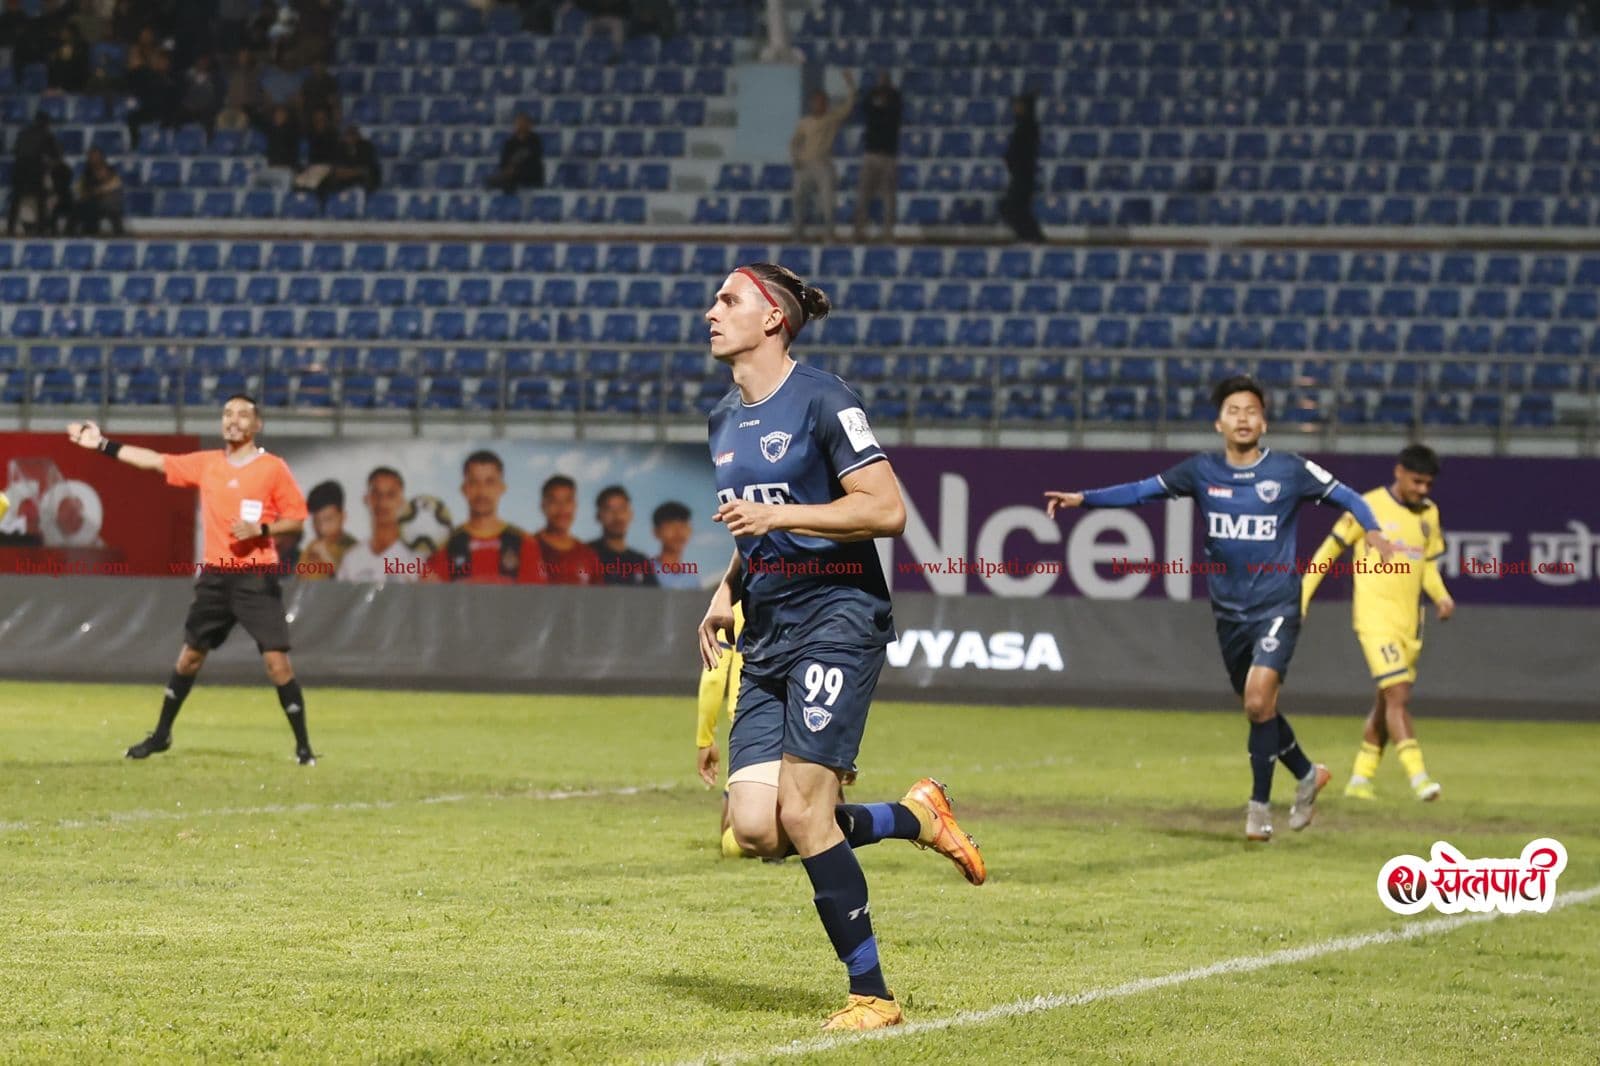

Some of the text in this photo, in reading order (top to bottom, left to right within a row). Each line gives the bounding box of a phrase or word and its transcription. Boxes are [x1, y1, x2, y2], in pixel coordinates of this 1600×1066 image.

[873, 472, 1193, 601] Ncel
[1208, 512, 1278, 541] IME
[1380, 643, 1400, 665] 15
[804, 663, 844, 707] 99
